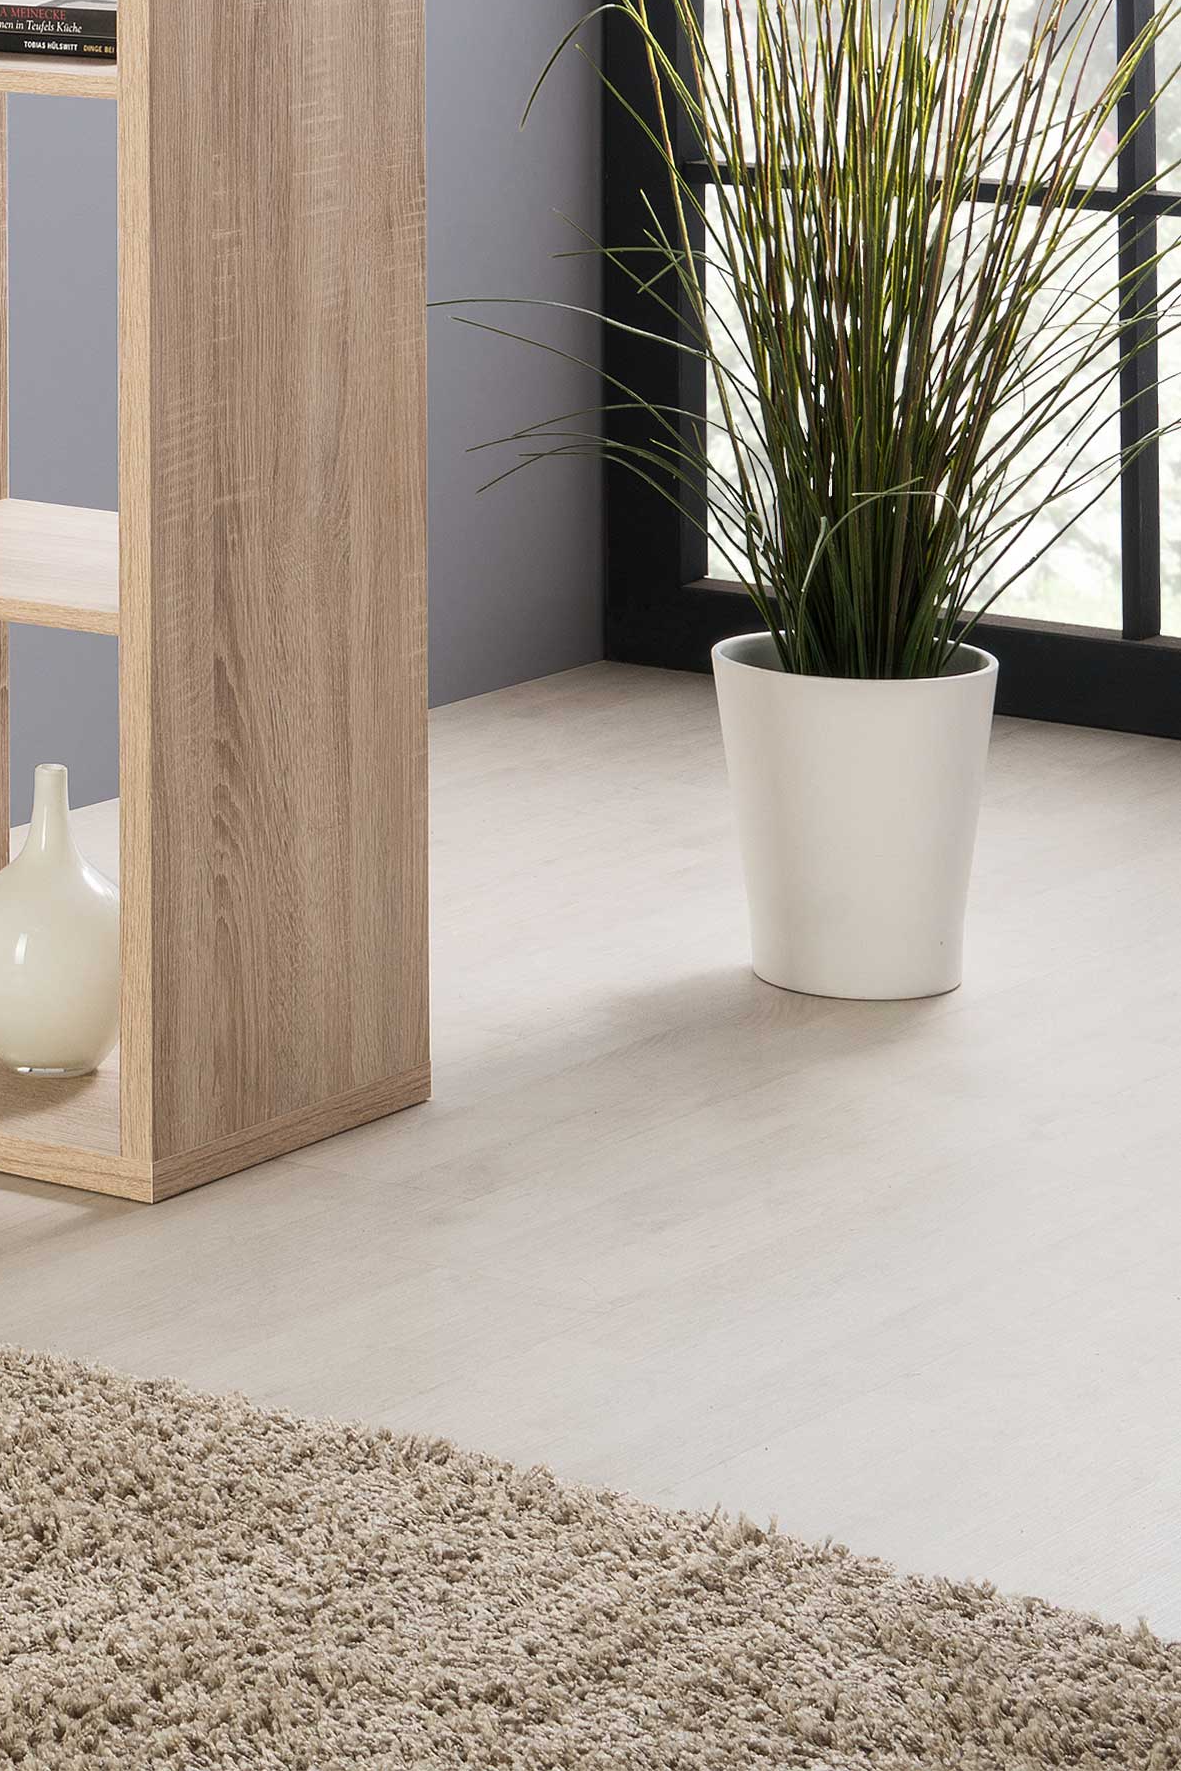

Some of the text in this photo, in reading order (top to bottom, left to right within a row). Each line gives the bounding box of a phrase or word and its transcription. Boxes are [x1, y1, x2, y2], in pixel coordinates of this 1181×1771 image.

[10, 7, 66, 20] MEINECKE
[16, 19, 24, 30] in
[26, 20, 55, 33] Teufels
[56, 23, 82, 33] Küche
[24, 40, 46, 49] TOBIAS
